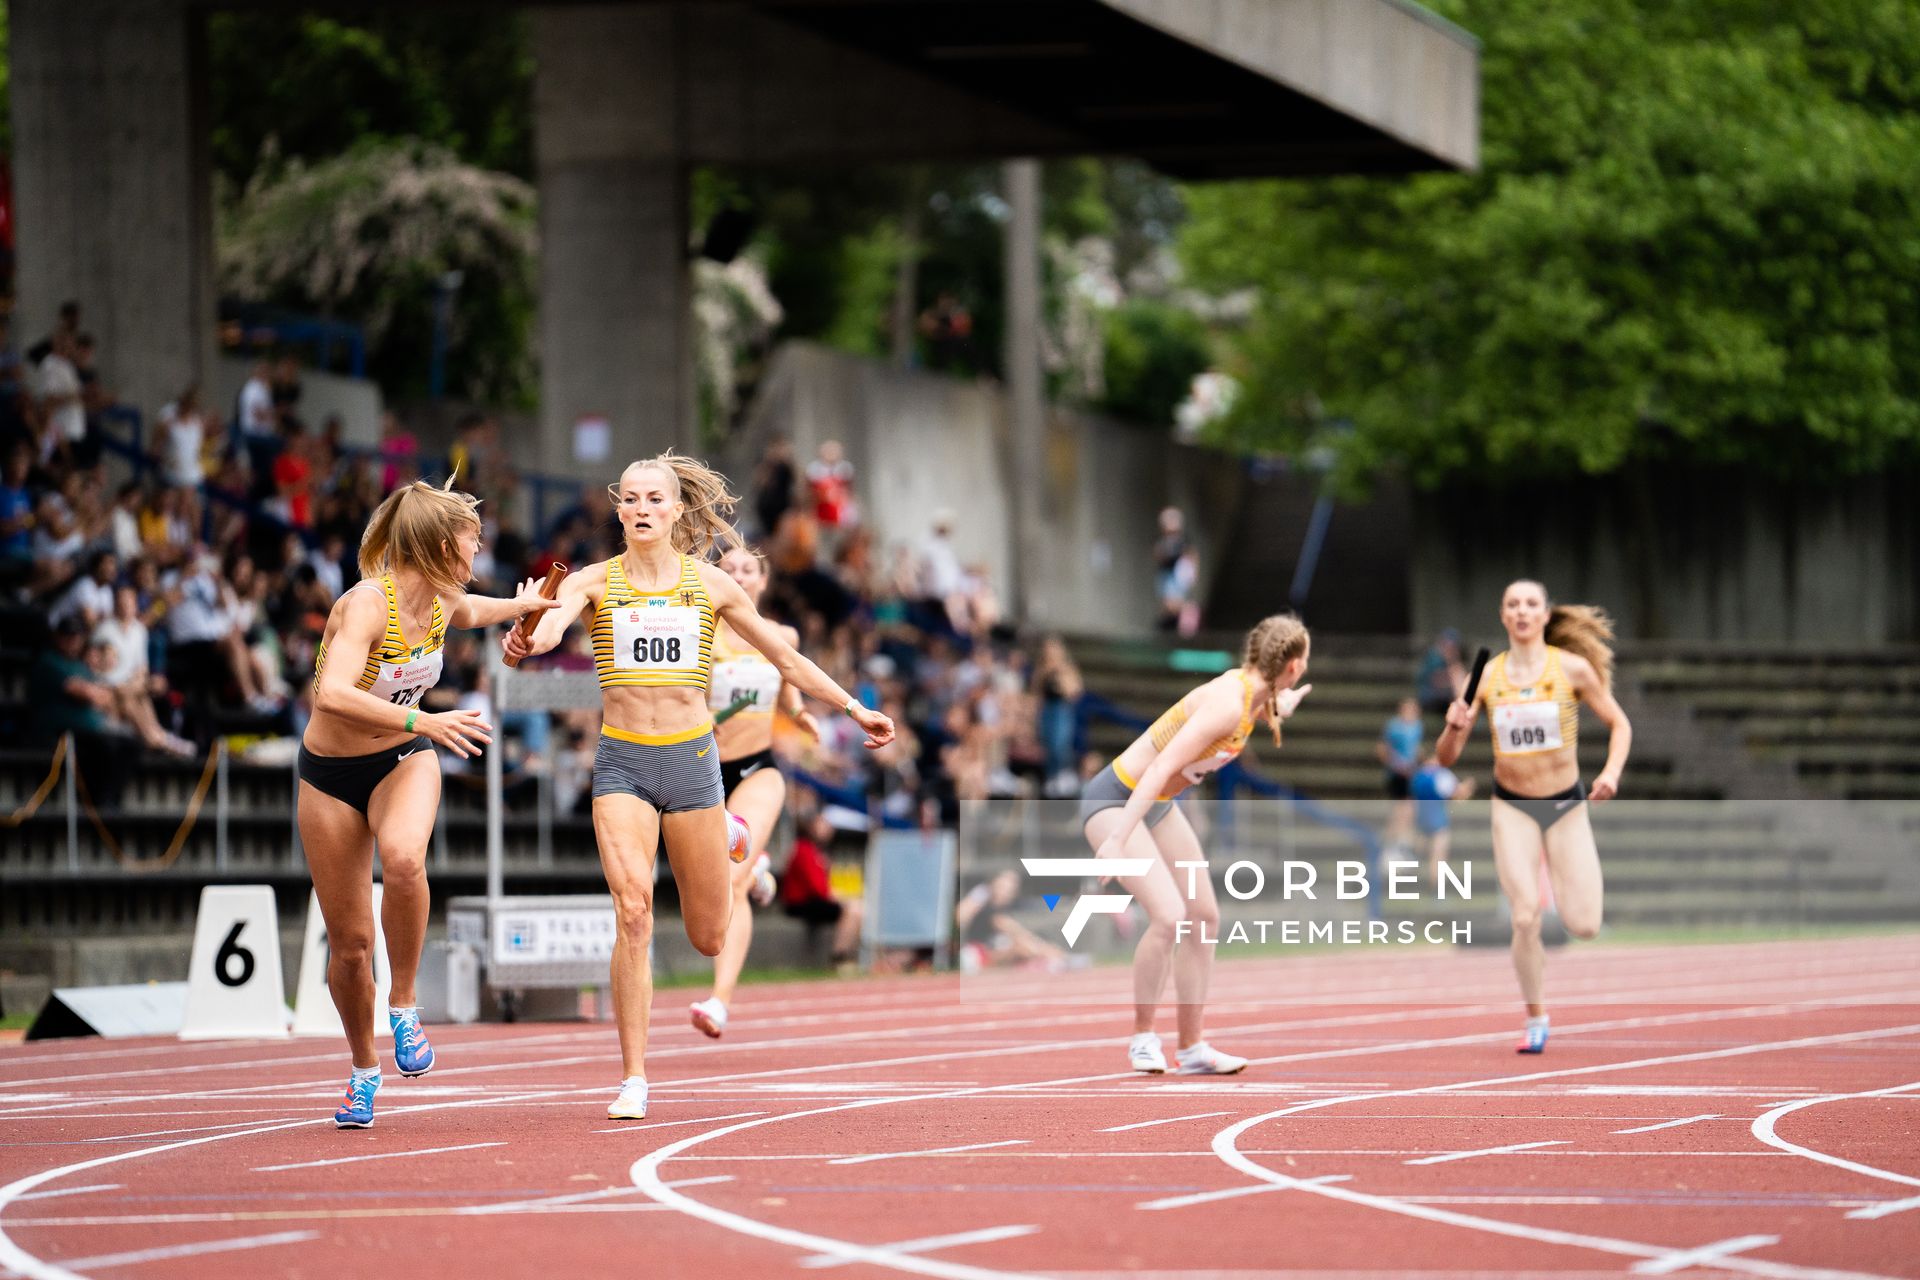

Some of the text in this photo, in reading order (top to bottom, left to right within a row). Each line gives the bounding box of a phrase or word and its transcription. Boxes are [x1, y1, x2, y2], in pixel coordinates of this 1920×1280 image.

[644, 615, 678, 623] Sparkasse
[643, 624, 685, 633] Regensburg
[633, 637, 681, 663] 608
[404, 665, 430, 678] Sparkasse
[401, 672, 433, 686] Regensburg
[1510, 727, 1545, 747] 609
[214, 920, 256, 988] 6
